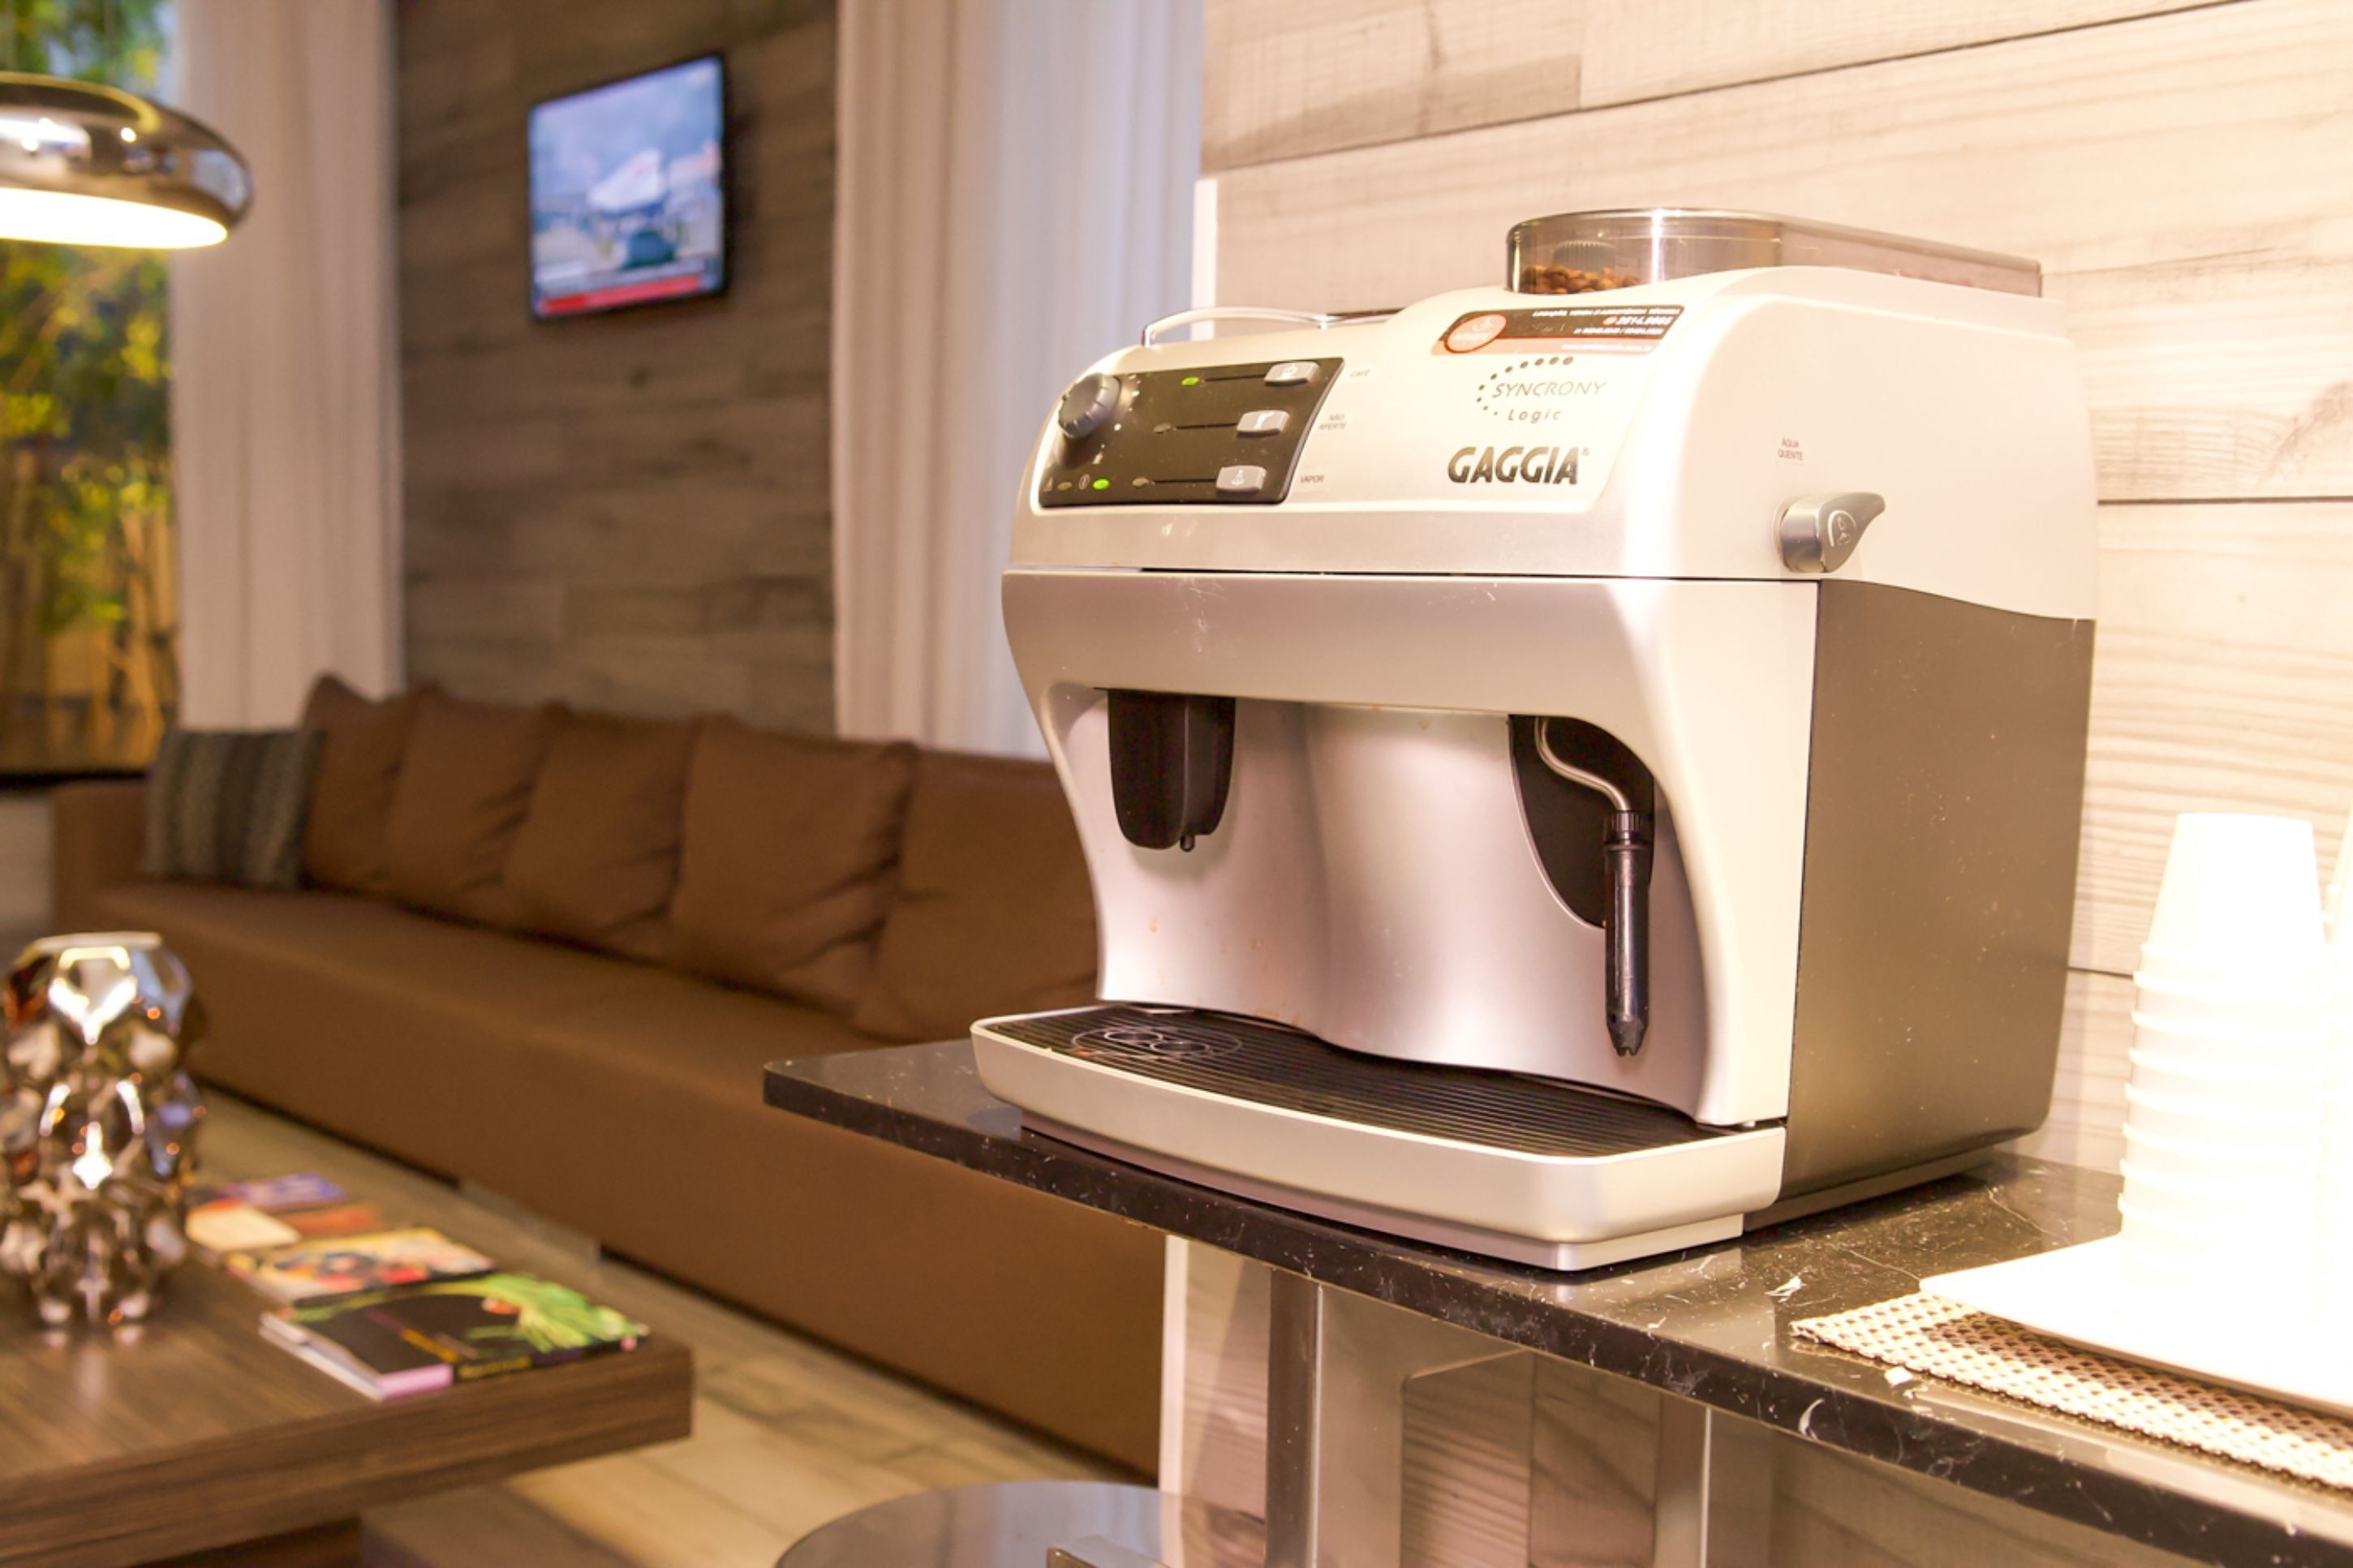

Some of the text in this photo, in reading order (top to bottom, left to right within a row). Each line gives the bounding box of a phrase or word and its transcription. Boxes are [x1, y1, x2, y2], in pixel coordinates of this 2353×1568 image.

[1491, 380, 1607, 398] SYNCRONY
[1507, 408, 1563, 423] Logic
[1777, 449, 1805, 461] QUENTE
[1448, 446, 1579, 485] GAGGIA
[1300, 475, 1325, 483] VAPOR
